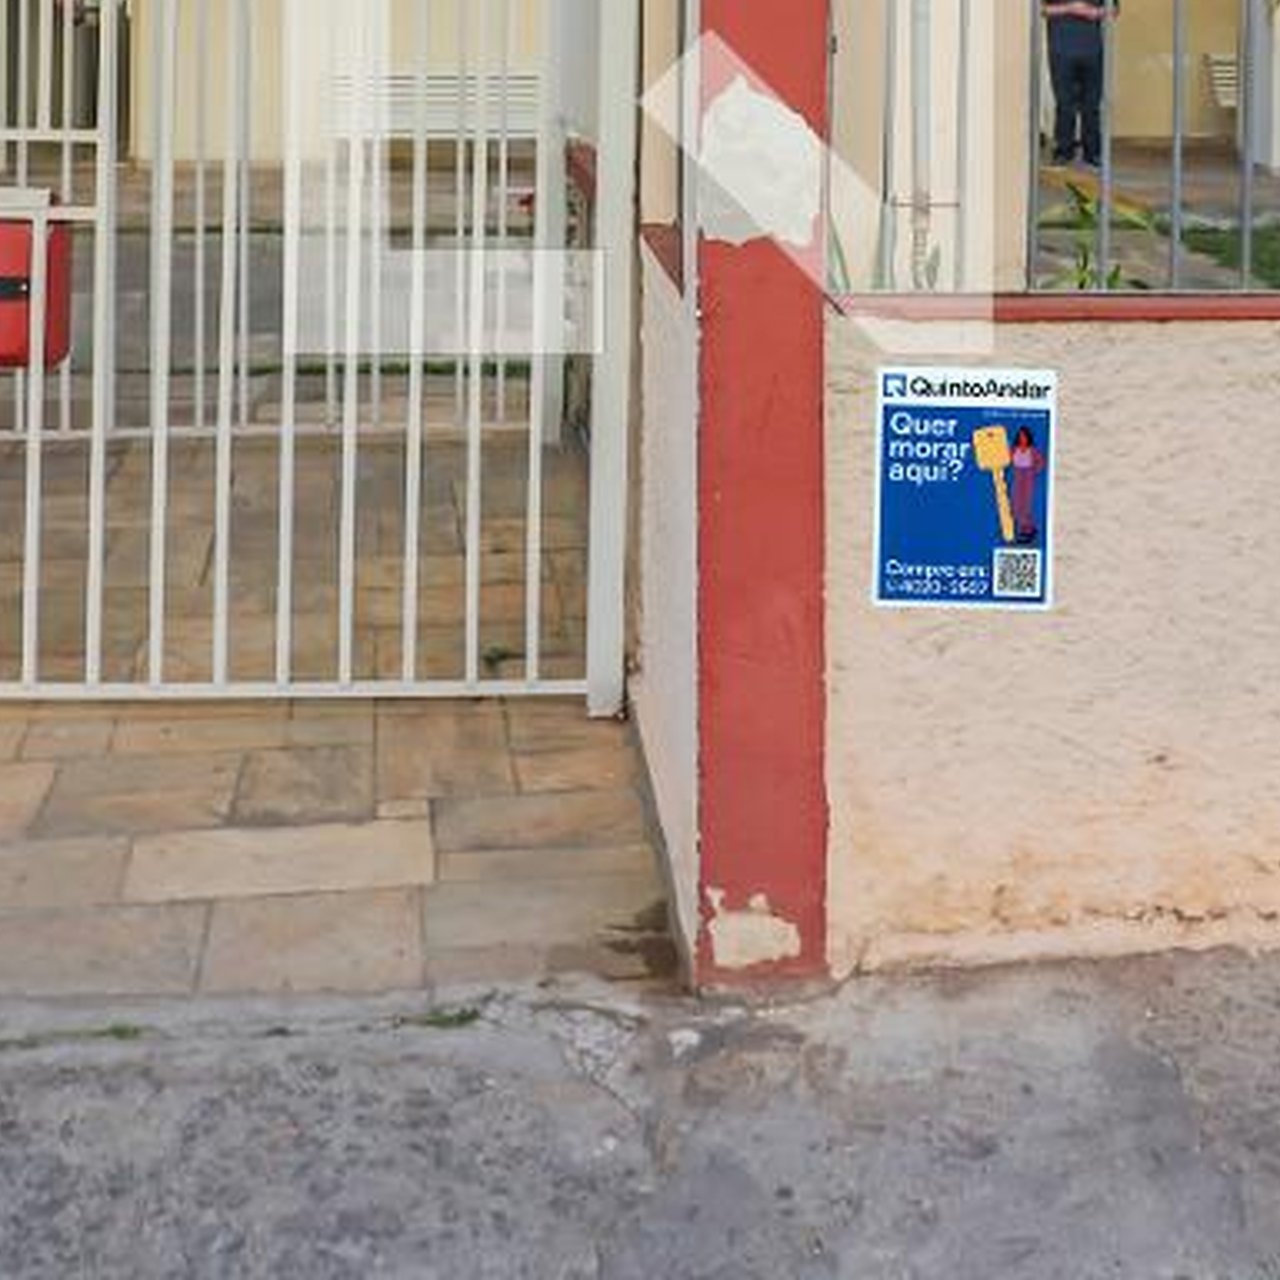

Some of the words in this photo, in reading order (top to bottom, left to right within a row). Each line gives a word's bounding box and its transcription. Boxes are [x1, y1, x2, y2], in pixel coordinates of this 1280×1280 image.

[910, 376, 1052, 399] QuintoAndar
[891, 412, 959, 435] Quer
[888, 440, 971, 459] morar
[888, 461, 965, 486] aqui?
